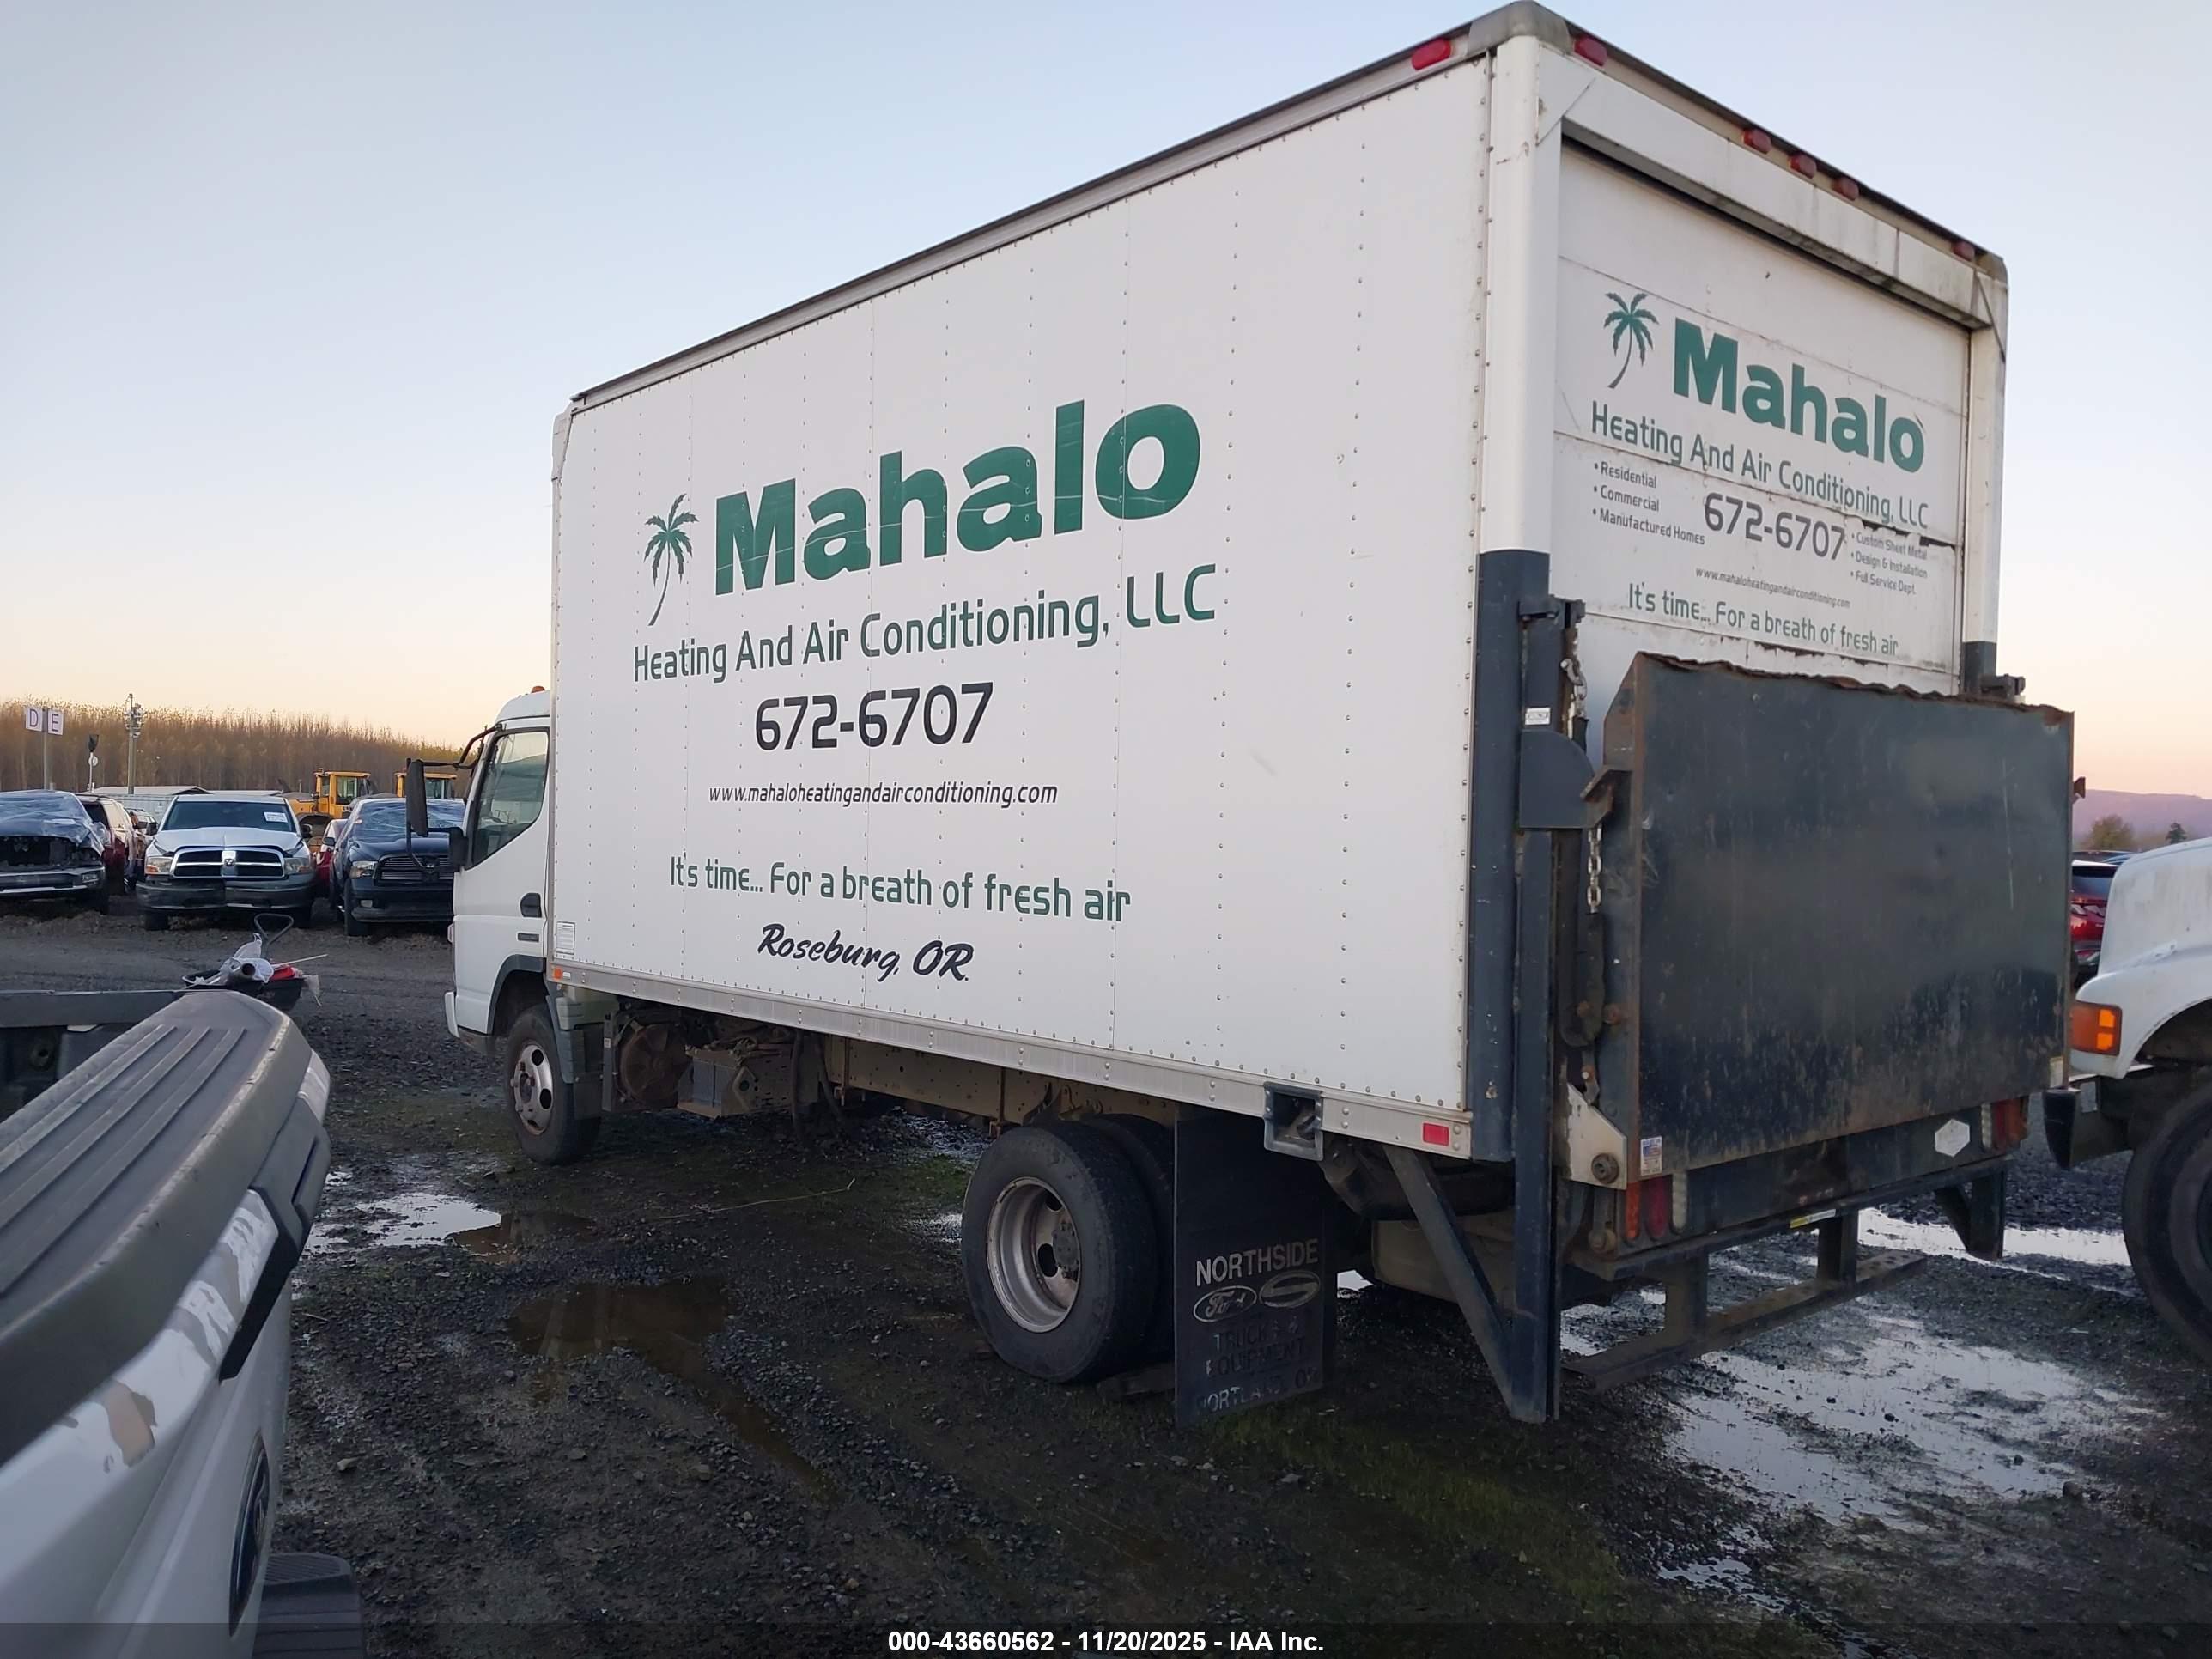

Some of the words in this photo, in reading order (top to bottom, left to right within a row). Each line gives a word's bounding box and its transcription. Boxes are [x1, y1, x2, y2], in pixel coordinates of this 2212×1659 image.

[1674, 317, 1925, 473] Mahalo
[1591, 400, 1683, 465] Heating
[1690, 433, 1735, 473] And
[1741, 448, 1772, 483] Air
[1778, 460, 1894, 525] Conditioning,
[1899, 495, 1929, 530] LLC
[1601, 461, 1657, 489] Residential
[715, 399, 1201, 596] Mahalo
[1600, 484, 1660, 513] Commercial
[1599, 507, 1672, 538] Manufactured
[1674, 526, 1706, 546] Homes
[1704, 492, 1846, 562] 672-6707
[1856, 532, 1884, 550] Custom
[1855, 550, 1881, 569] Design
[635, 638, 727, 684] Heating
[735, 624, 793, 672] And
[803, 618, 850, 665] Air
[860, 589, 1111, 658] Conditioning,
[1126, 563, 1217, 629] LLC
[1629, 582, 1656, 613] It's
[1716, 601, 1746, 629] For
[1750, 612, 1760, 631] a
[1765, 610, 1816, 644] breath
[1820, 625, 1837, 646] of
[1840, 625, 1877, 654] fresh
[1881, 635, 1899, 656] air
[29, 708, 39, 728] D
[51, 713, 59, 732] E
[756, 682, 994, 750] 672-6707
[708, 781, 1059, 809] www.mahaloheatingandairconditioning.com
[671, 852, 698, 888] It's
[705, 858, 763, 894] time...
[770, 861, 812, 897] For
[820, 871, 835, 899] a
[842, 866, 933, 907] breath
[942, 872, 974, 910] of
[985, 873, 1072, 919] fresh
[1084, 880, 1131, 923] air
[757, 921, 901, 983] Roseburg,
[1196, 1237, 1319, 1287] NORTHSIDE
